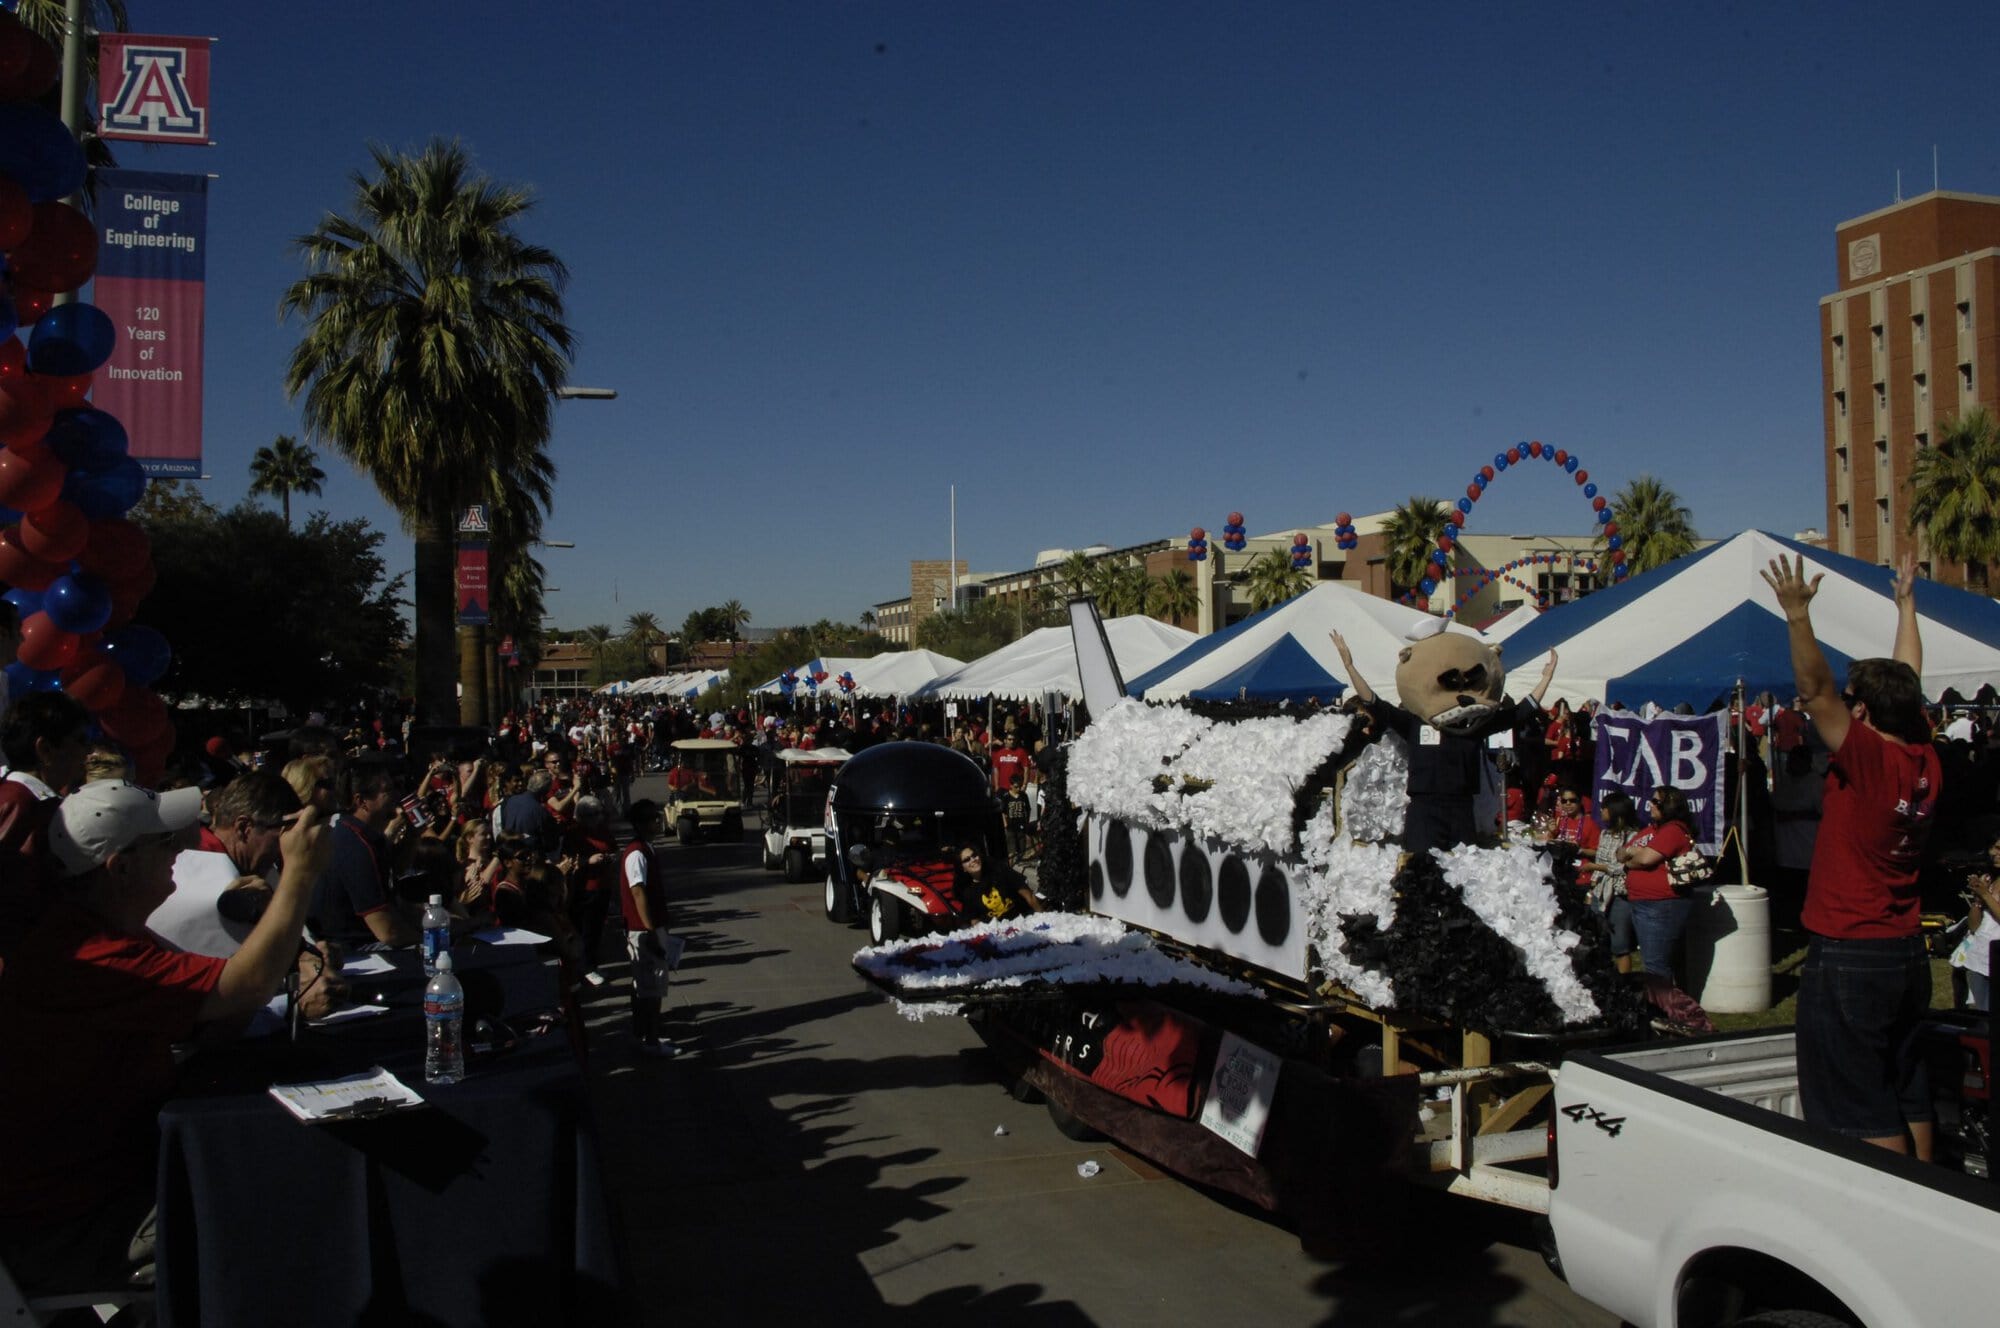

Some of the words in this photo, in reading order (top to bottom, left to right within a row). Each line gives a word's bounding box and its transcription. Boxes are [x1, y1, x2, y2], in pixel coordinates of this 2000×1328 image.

[102, 45, 205, 138] A
[124, 193, 180, 215] College
[143, 213, 160, 229] of
[105, 228, 196, 252] Engineering
[135, 307, 160, 321] 120
[127, 326, 166, 341] Years
[139, 346, 155, 360] of
[108, 365, 183, 381] Innovation
[1561, 1103, 1626, 1138] 4x4
